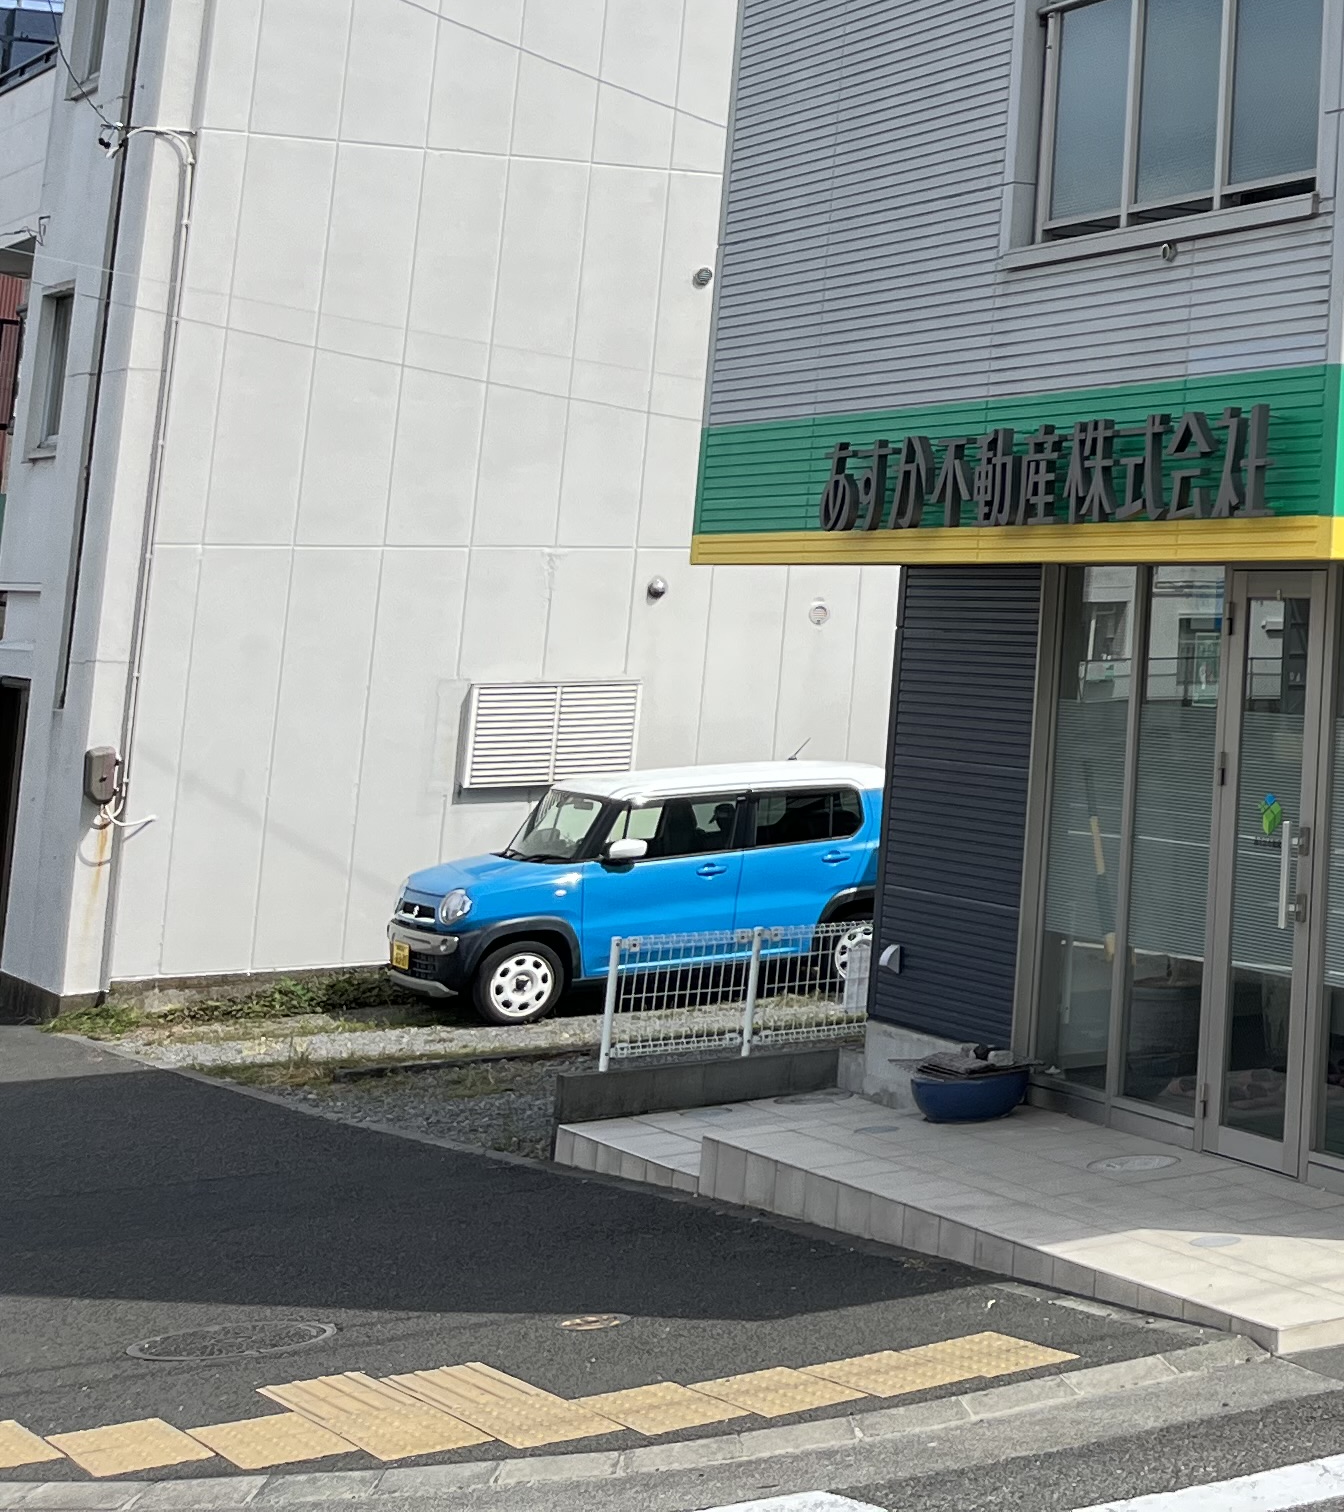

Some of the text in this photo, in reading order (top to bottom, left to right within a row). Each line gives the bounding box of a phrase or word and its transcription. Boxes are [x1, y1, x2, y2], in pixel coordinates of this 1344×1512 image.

[819, 403, 1275, 531] あすか不動産株式会社
